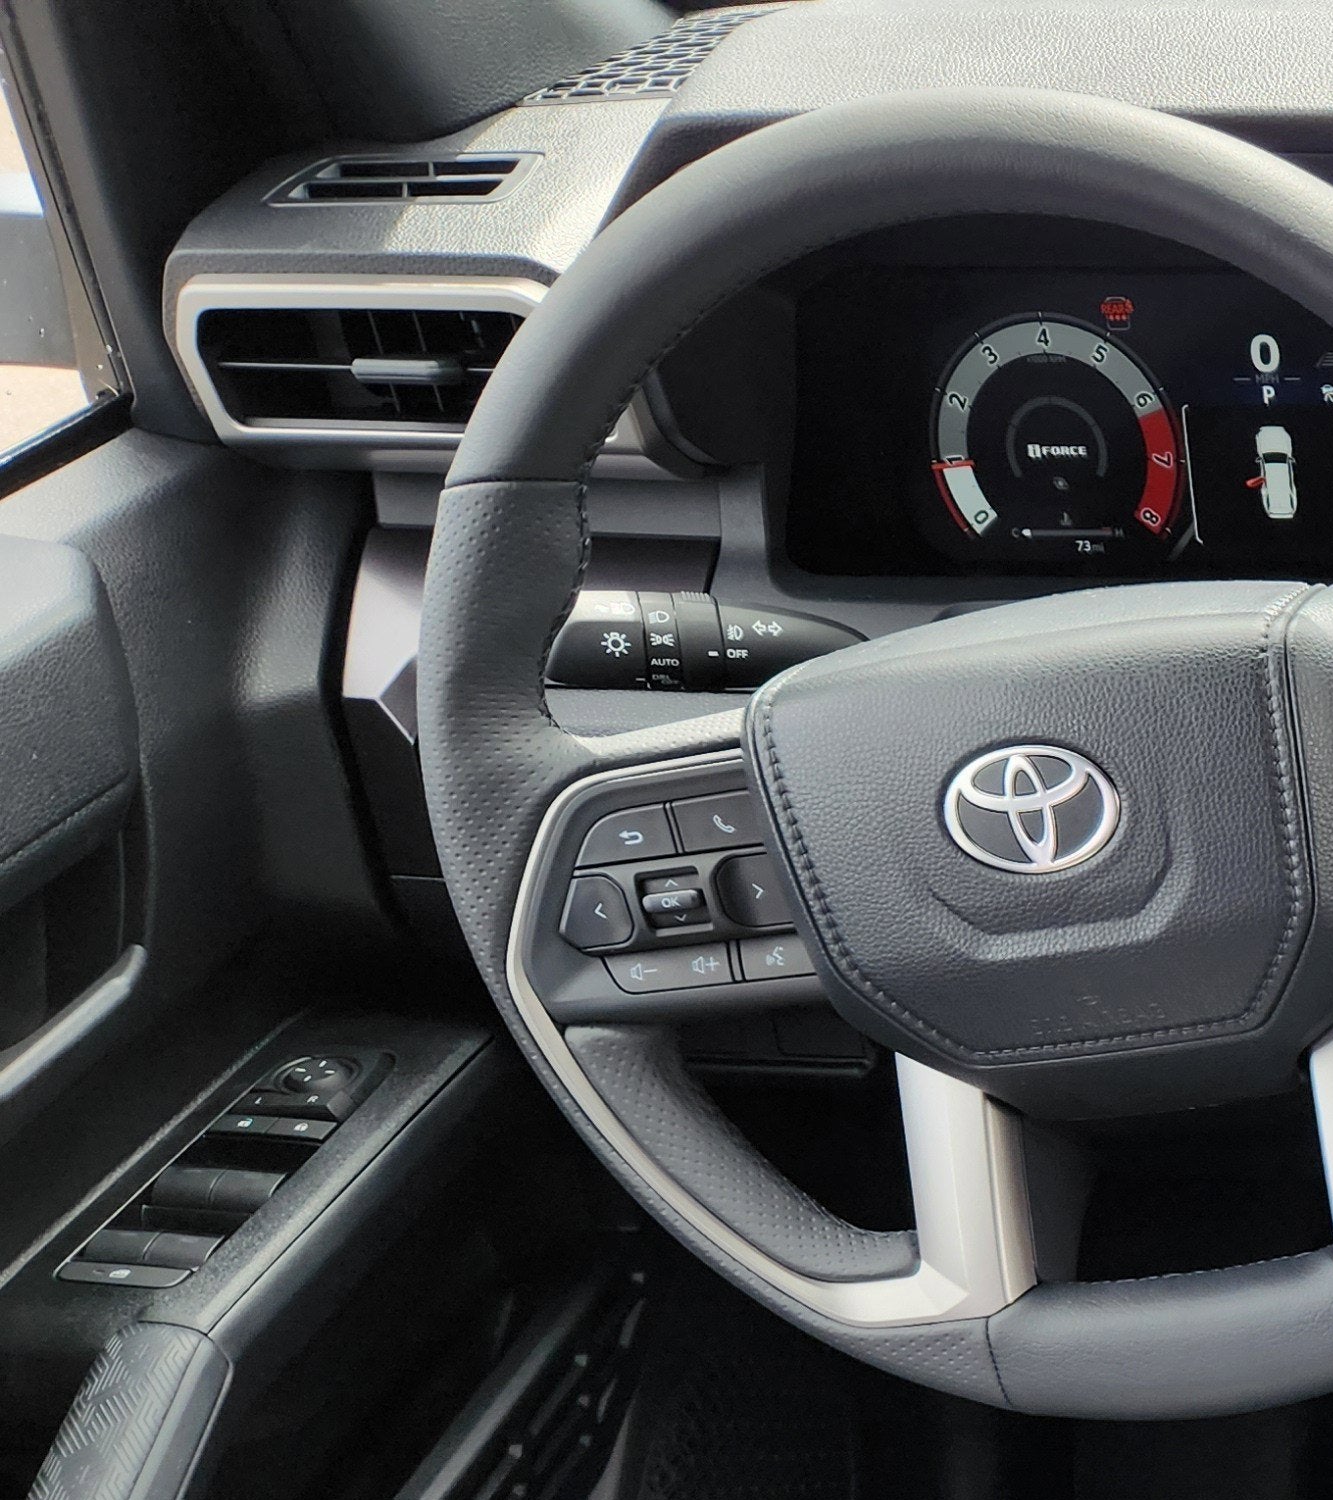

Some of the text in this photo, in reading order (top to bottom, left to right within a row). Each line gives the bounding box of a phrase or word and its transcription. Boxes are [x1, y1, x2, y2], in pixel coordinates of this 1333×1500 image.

[1036, 328, 1050, 347] 4
[980, 345, 999, 366] 3
[1090, 343, 1109, 365] 5
[1250, 333, 1281, 374] 0
[948, 392, 969, 412] 2
[1135, 391, 1155, 409] 6
[1261, 385, 1276, 406] P
[1152, 452, 1173, 468] 7
[973, 509, 989, 525] 0
[1140, 507, 1161, 526] 8
[650, 657, 680, 668] AUTO
[726, 648, 749, 660] OFF
[660, 896, 681, 909] OK
